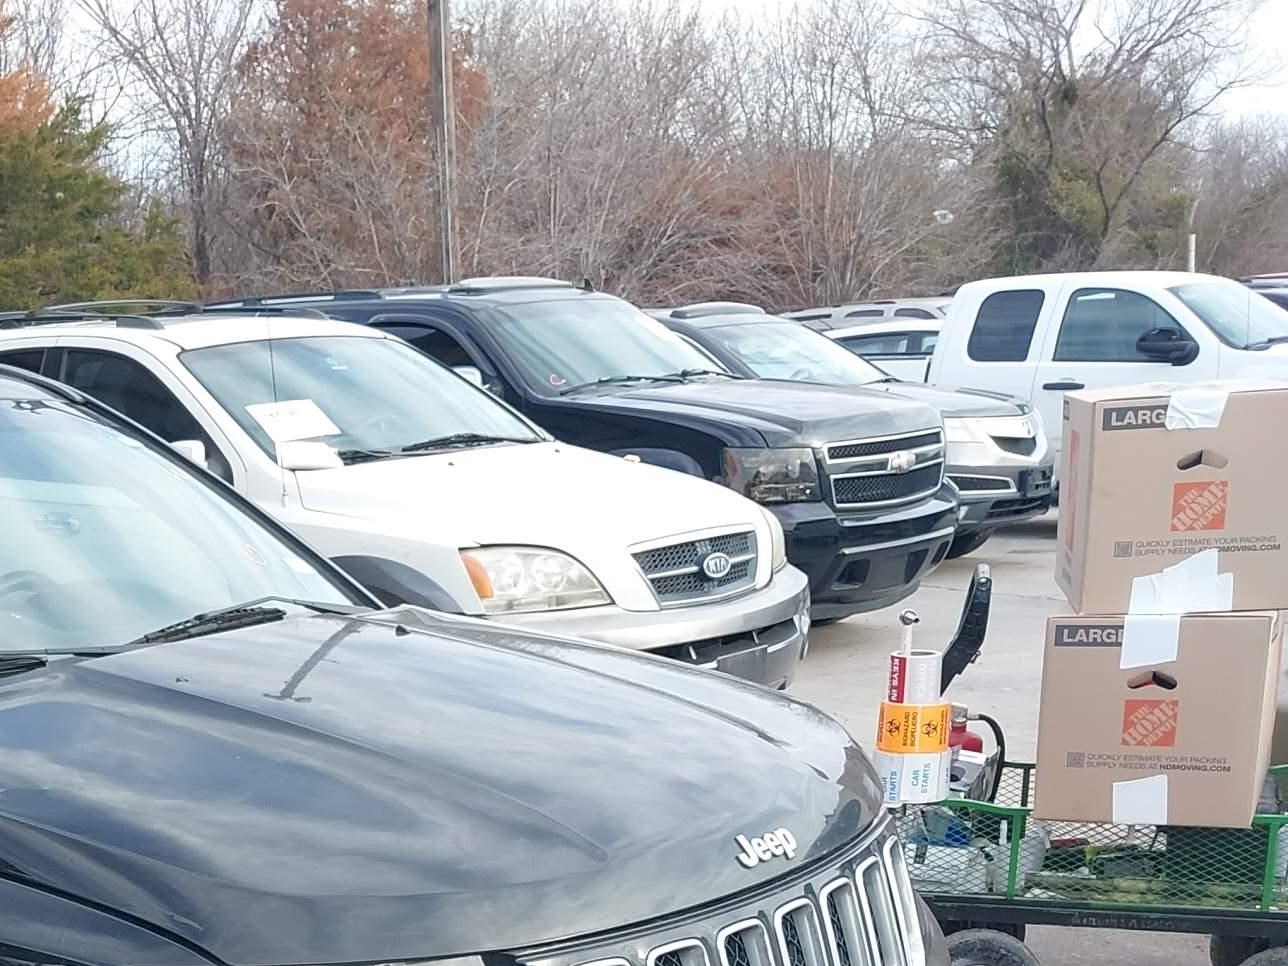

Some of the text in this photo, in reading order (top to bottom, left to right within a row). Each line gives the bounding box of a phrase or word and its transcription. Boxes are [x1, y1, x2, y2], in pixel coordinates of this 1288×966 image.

[1111, 409, 1167, 426] LARG
[1172, 480, 1227, 531] HOME
[1177, 488, 1200, 506] THE
[1192, 499, 1226, 530] DEPOT
[1135, 535, 1277, 549] QUICKLY ESTIMATE YOUR PACKING
[1135, 548, 1164, 557] SUPPLY
[1165, 547, 1195, 555] NEEDS
[708, 558, 727, 573] KIA
[890, 658, 900, 701] KEYS IN
[1122, 700, 1178, 746] HOME
[1128, 704, 1150, 722] THE
[902, 711, 910, 747] BIOHAZARD
[1143, 720, 1177, 746] DEPOT
[1086, 761, 1117, 769] SUPPLY
[1147, 762, 1159, 770] AT
[1159, 764, 1231, 772] HDMOVING.COM
[1087, 753, 1227, 765] QUICKLY ESTIMATE YOUR PACKING
[889, 771, 897, 802] STARTS
[921, 763, 931, 794] STARTS
[734, 827, 797, 868] Jeep
